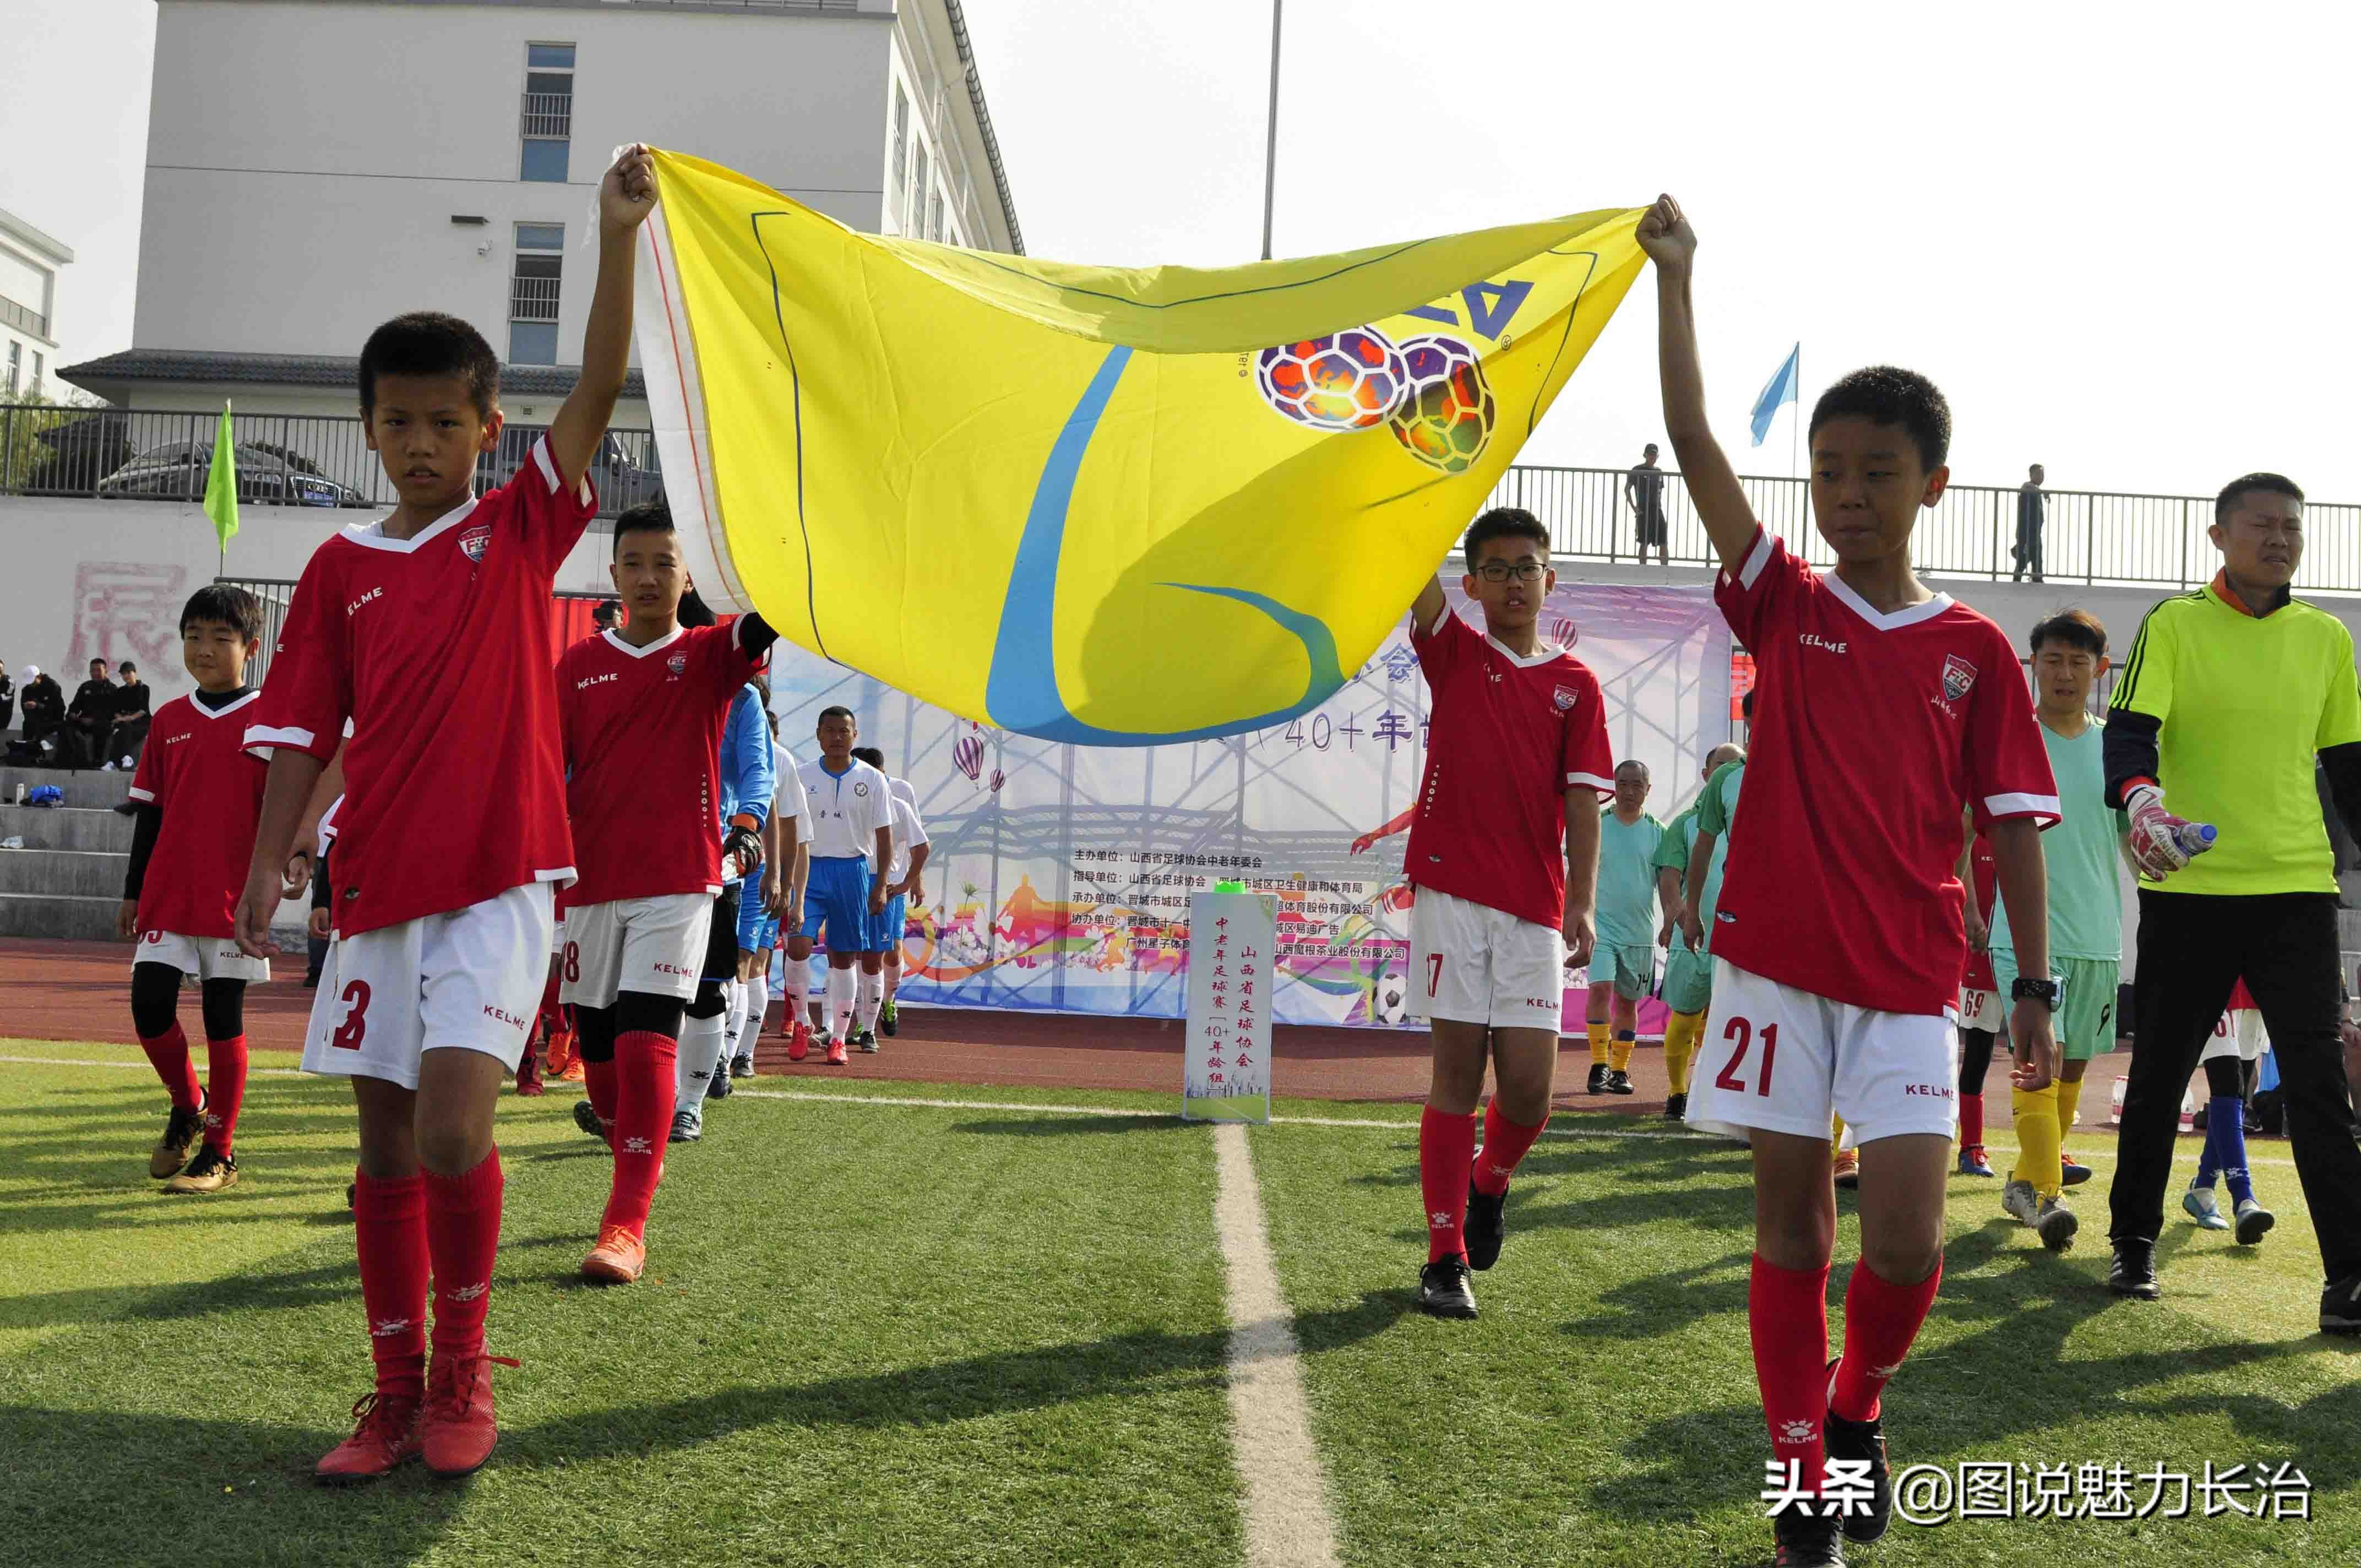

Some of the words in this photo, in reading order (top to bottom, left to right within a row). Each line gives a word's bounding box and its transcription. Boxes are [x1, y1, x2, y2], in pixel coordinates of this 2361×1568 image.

[348, 587, 383, 616] ELME
[578, 673, 618, 690] KELME
[166, 733, 192, 744] KELME
[654, 962, 693, 978] KELME
[1236, 945, 1257, 1067] 山西省足球协会
[1526, 998, 1560, 1010] KELM
[1964, 989, 1984, 1017] 69
[483, 1005, 526, 1031] KELME
[1715, 1016, 1778, 1097] 21
[1779, 1433, 1818, 1444] KELME
